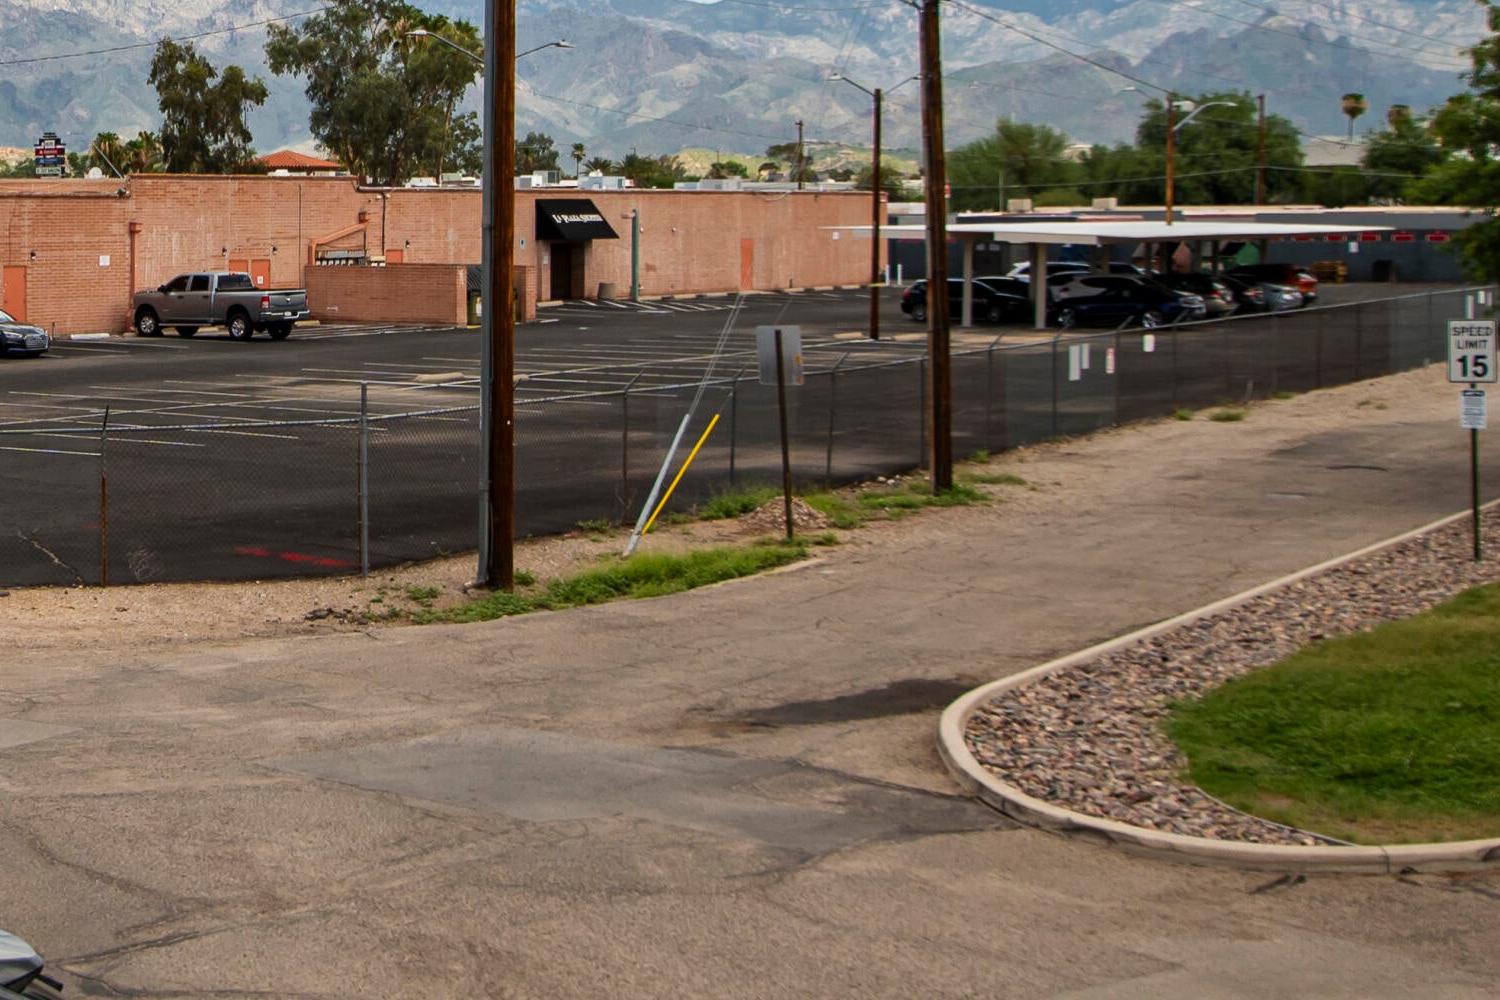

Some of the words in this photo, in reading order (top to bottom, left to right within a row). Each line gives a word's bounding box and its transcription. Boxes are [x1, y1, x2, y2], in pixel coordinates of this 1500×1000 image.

[1453, 326, 1493, 337] SPEED
[1457, 339, 1488, 350] LIMIT
[1456, 354, 1489, 378] 15
